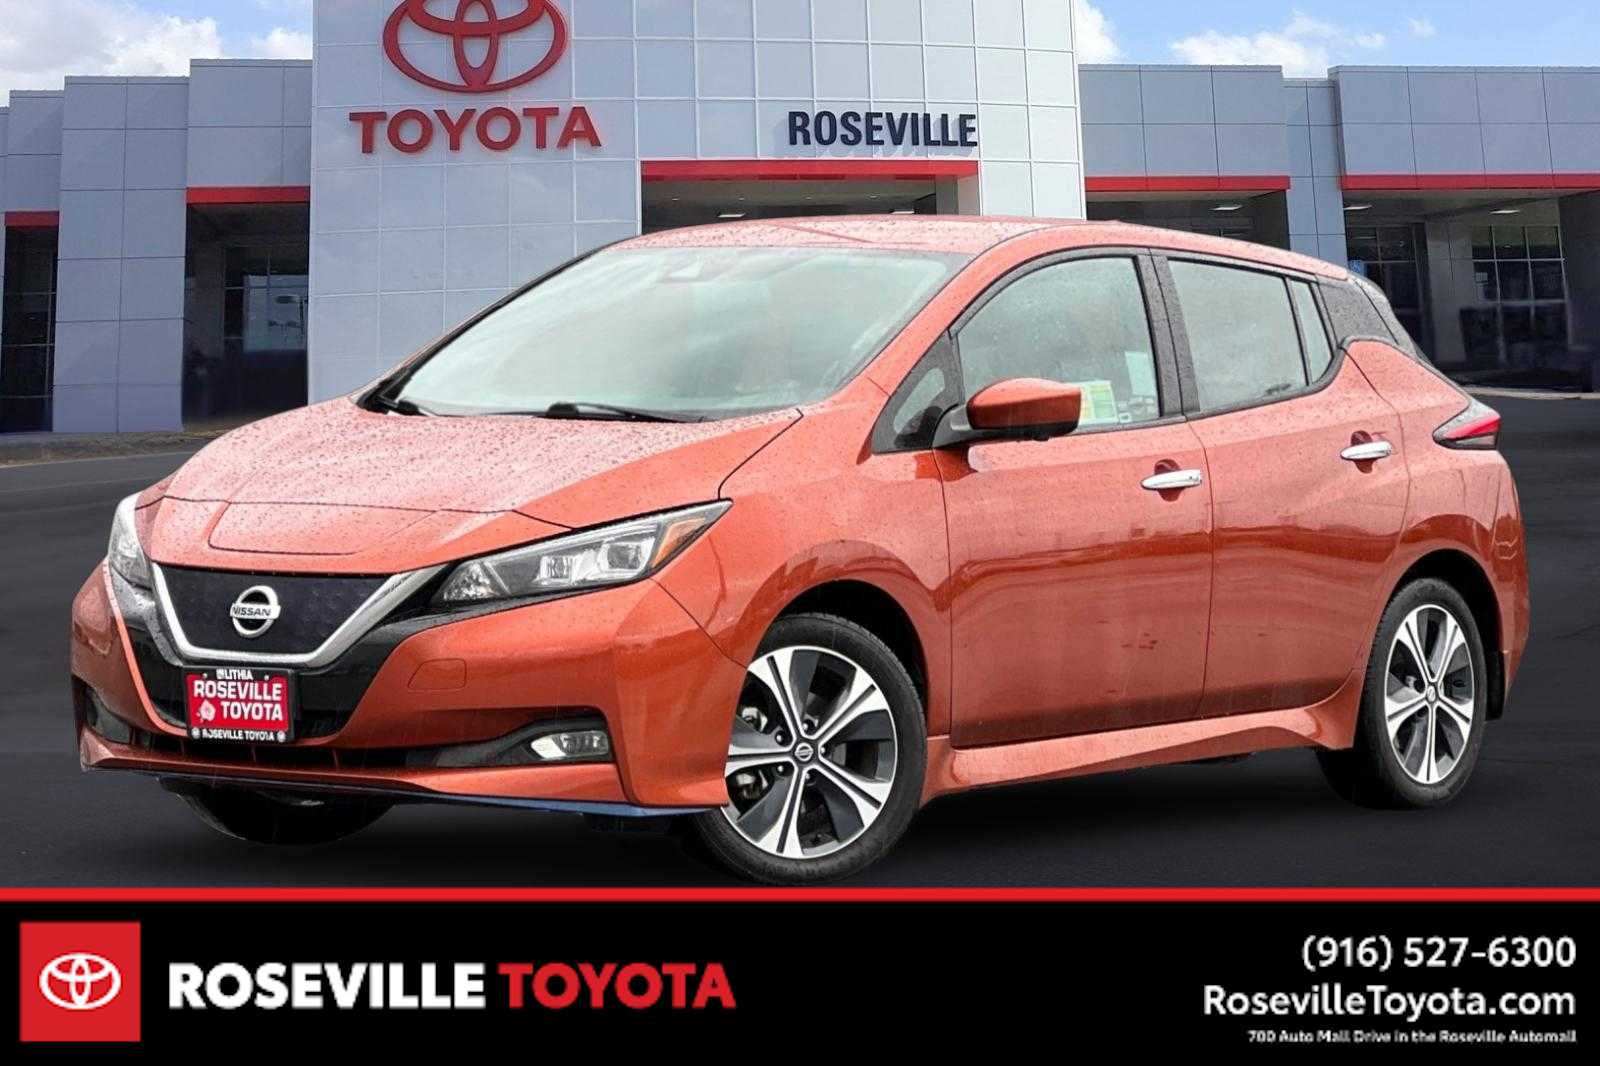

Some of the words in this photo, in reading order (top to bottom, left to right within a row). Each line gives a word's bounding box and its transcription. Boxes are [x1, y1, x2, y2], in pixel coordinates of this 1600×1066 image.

[350, 106, 602, 154] TOYOTA
[788, 110, 978, 147] ROSEVILLE
[232, 605, 273, 617] NISSAN
[224, 669, 254, 680] LITHIA
[193, 679, 283, 701] ROSEVILLE
[220, 700, 283, 721] TOYOTA
